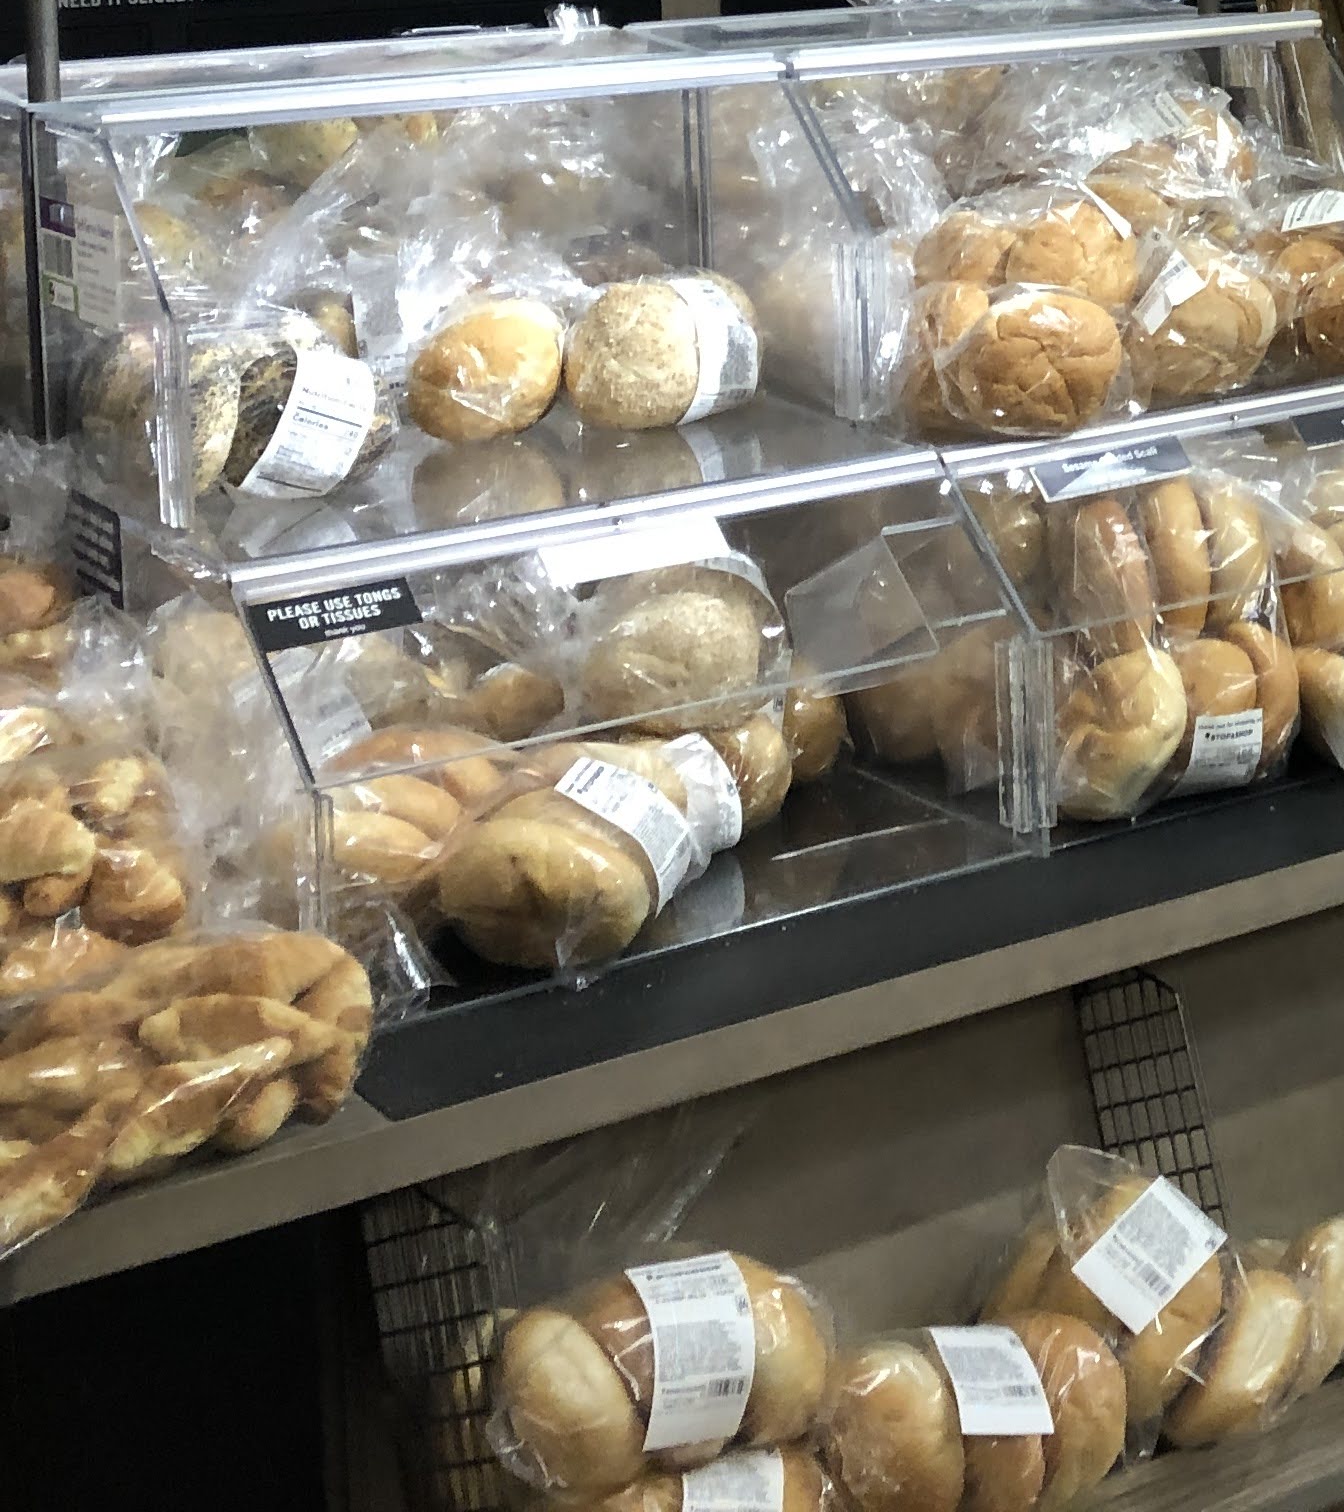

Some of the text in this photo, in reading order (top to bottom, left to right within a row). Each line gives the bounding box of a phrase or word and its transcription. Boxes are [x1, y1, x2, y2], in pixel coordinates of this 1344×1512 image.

[292, 414, 329, 430] Calories
[1133, 445, 1158, 459] Scali
[267, 587, 402, 622] PLEASE USE TONGS
[298, 604, 382, 630] OR TISSUES
